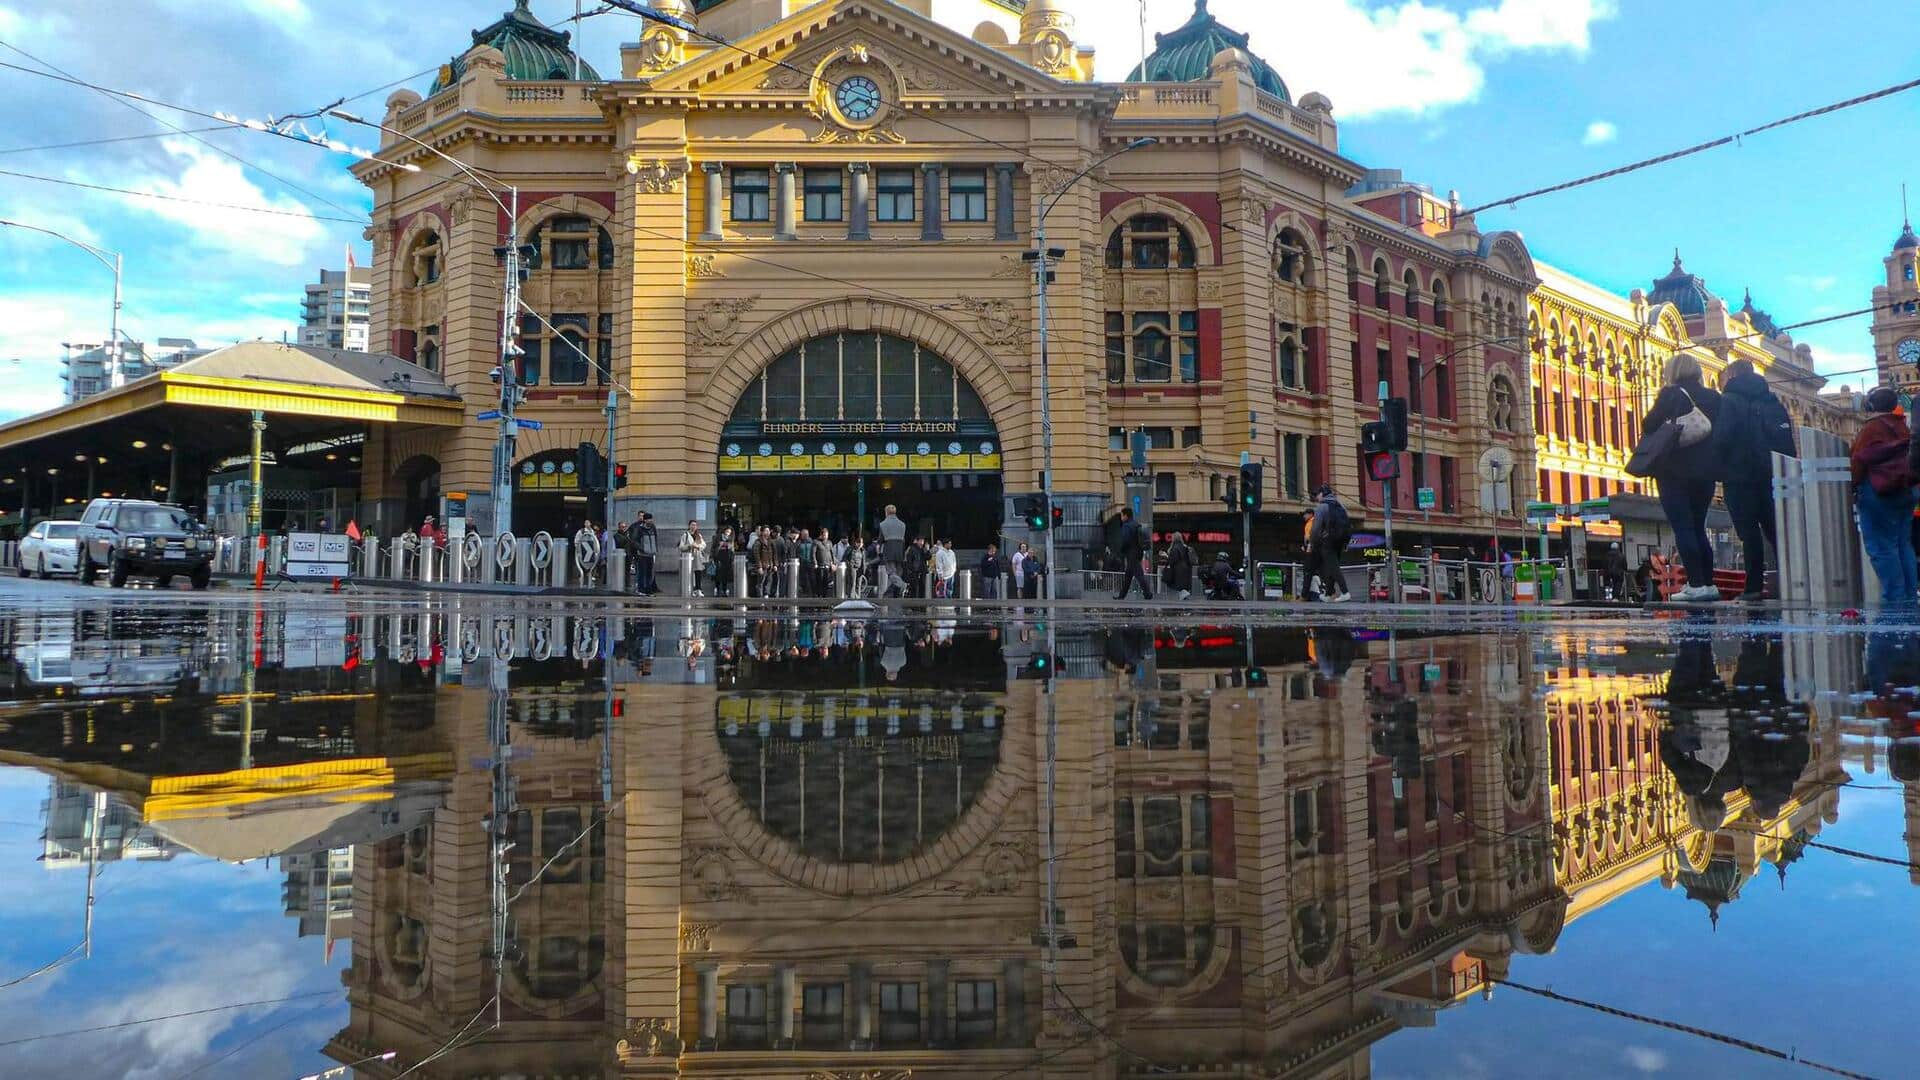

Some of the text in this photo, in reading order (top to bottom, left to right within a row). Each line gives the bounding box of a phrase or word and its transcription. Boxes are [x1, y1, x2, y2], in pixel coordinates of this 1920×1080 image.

[763, 422, 956, 433] FLINDERS STREET STATION
